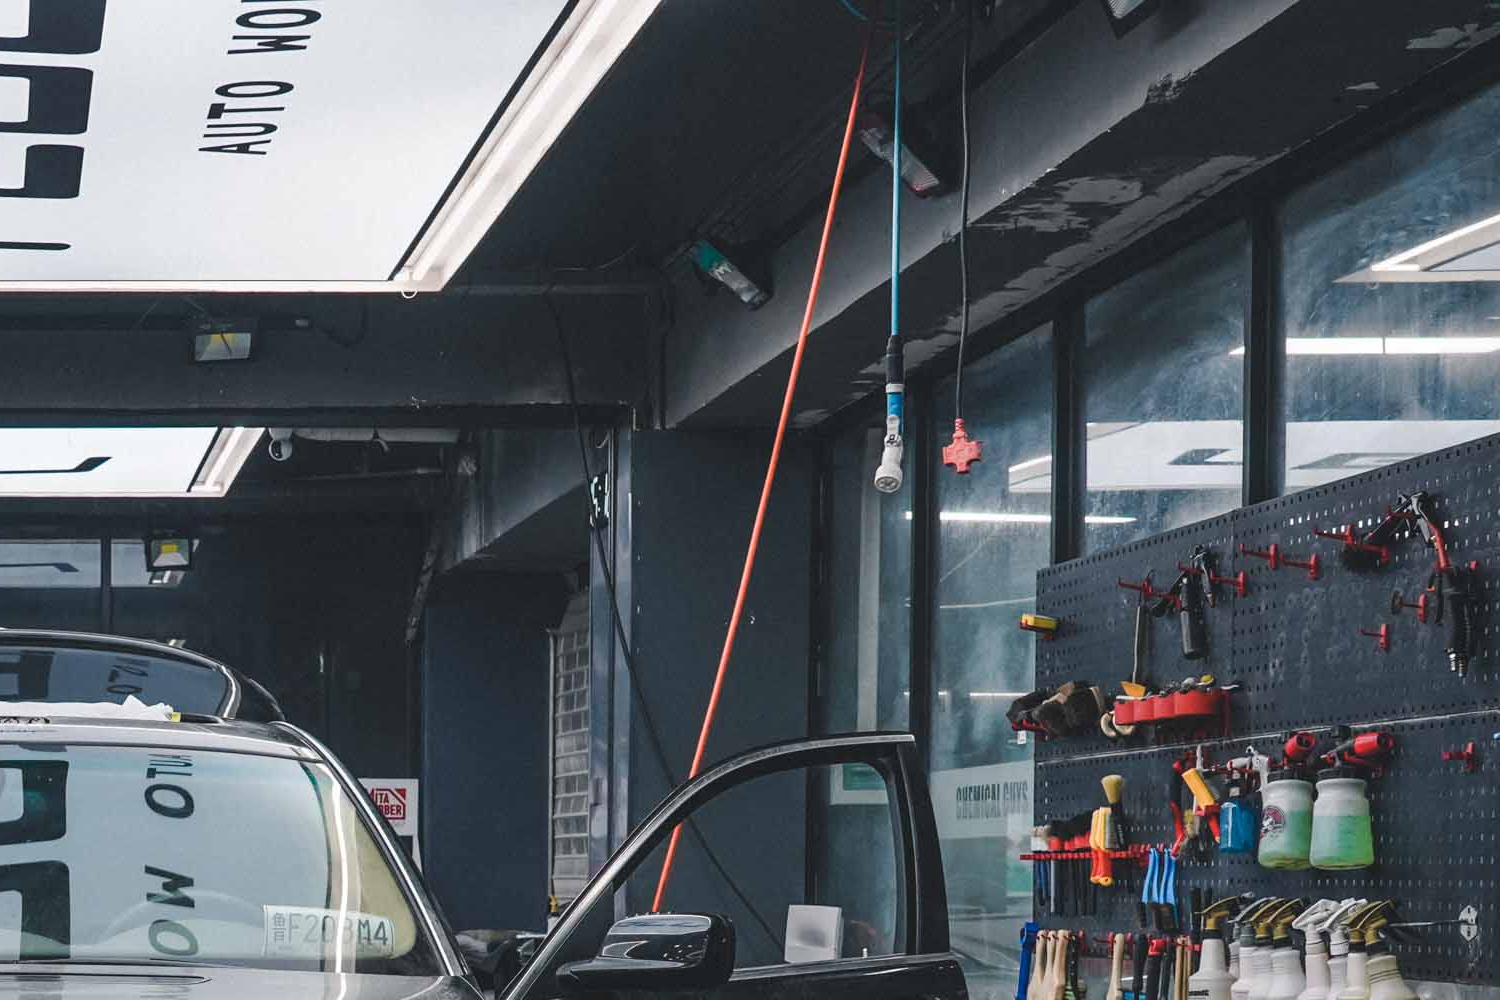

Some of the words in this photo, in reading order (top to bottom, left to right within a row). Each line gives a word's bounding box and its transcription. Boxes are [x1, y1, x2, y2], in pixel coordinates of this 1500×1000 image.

[227, 0, 322, 55] WO
[198, 79, 295, 156] AUTO
[378, 804, 402, 816] BBER
